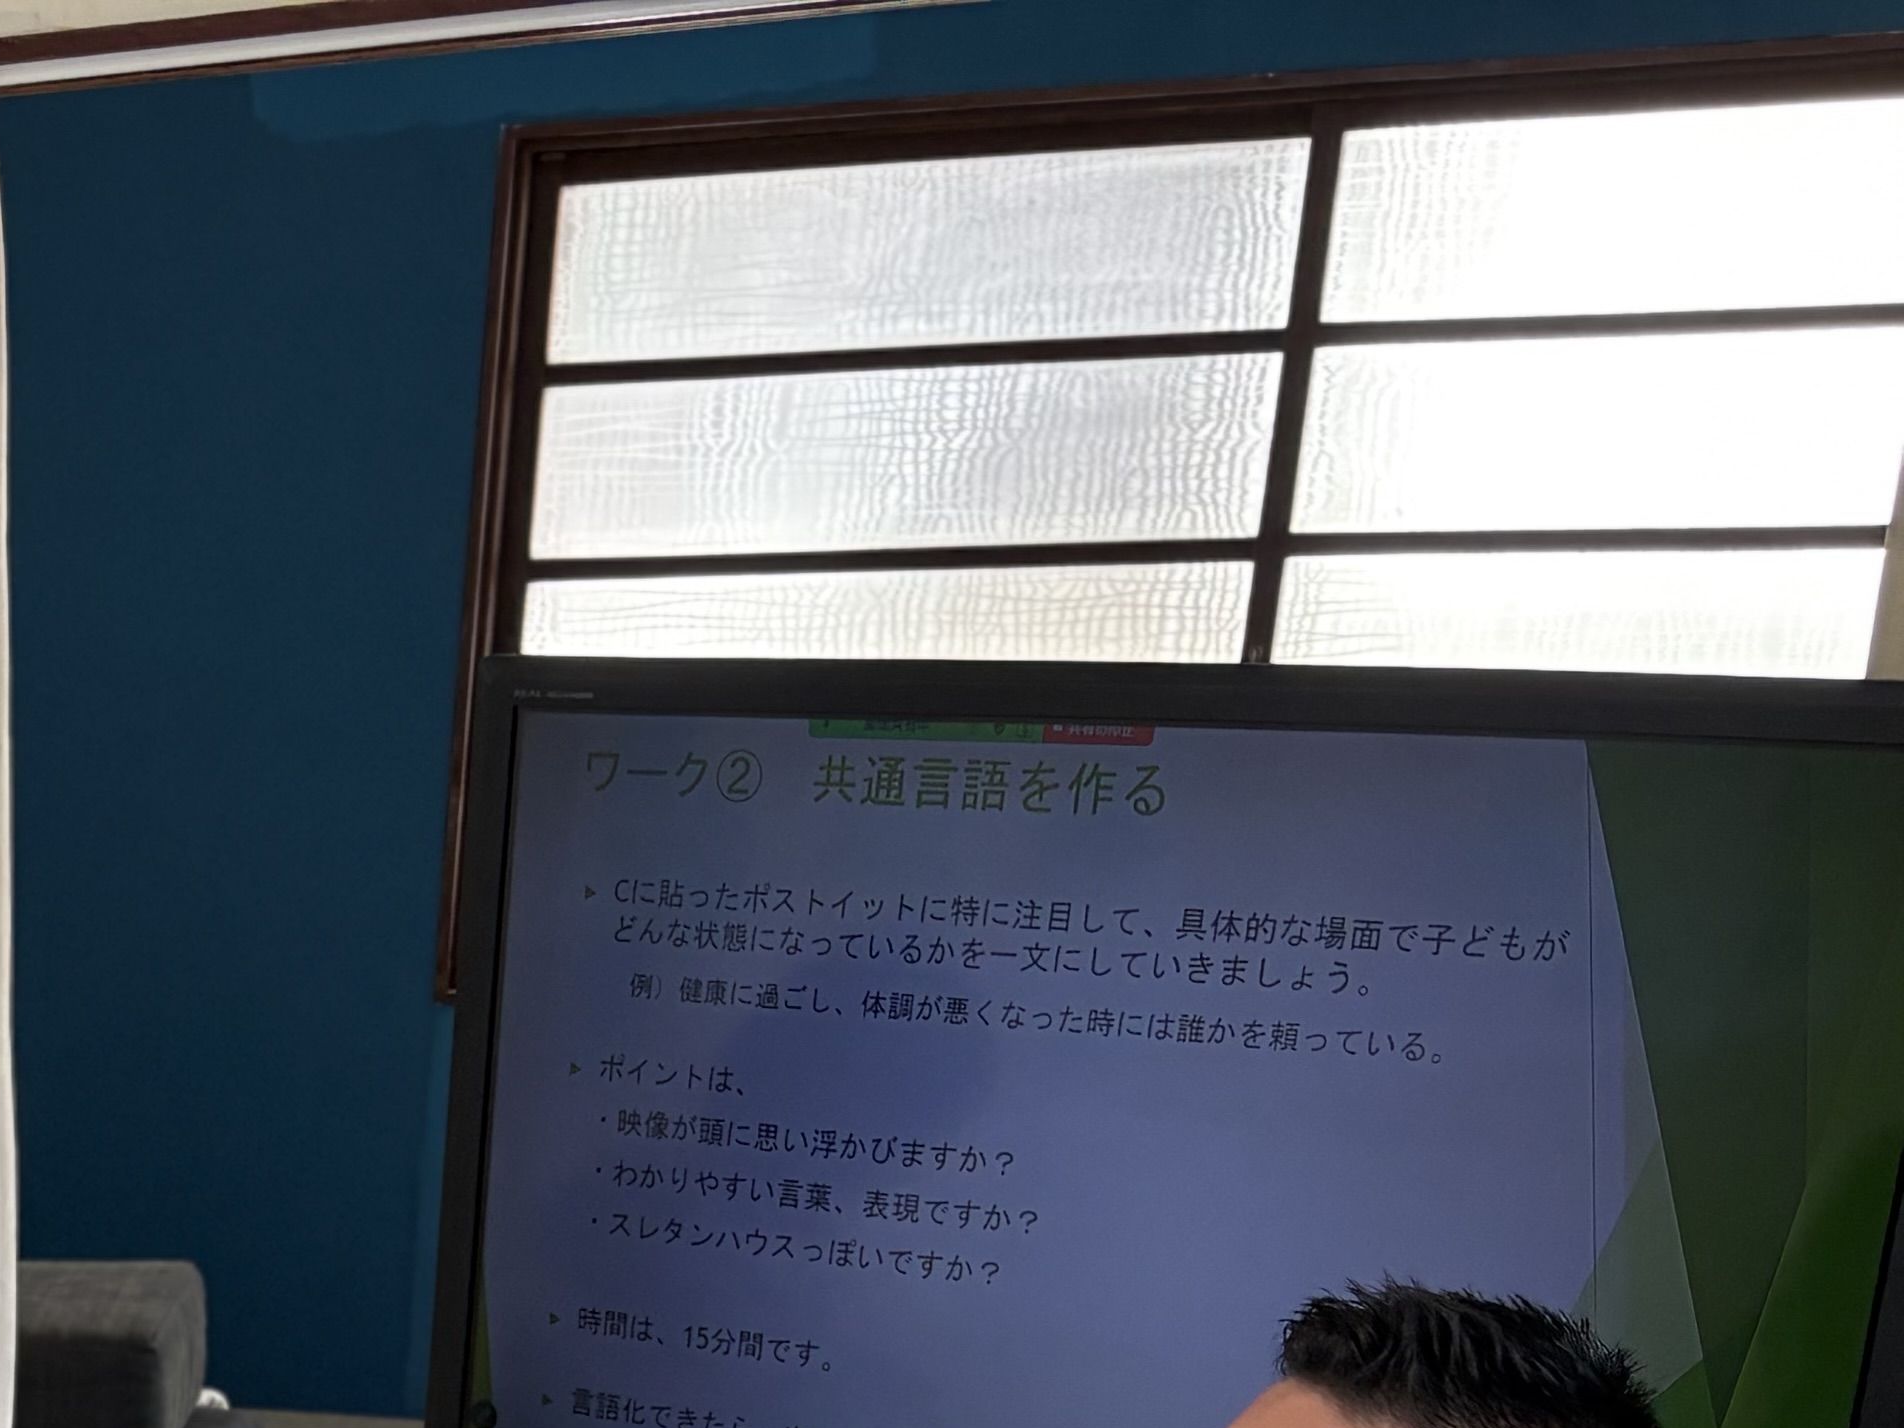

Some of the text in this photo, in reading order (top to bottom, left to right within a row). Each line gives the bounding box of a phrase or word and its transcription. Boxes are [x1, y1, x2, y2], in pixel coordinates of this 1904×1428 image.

[586, 748, 1166, 816] ワーク② 共通言語を作る
[612, 918, 1371, 997] どんな状態になっているかを一文にしていきましょう。
[599, 1053, 746, 1096] ポイントは、
[577, 1308, 834, 1374] 時間は、15分間です。
